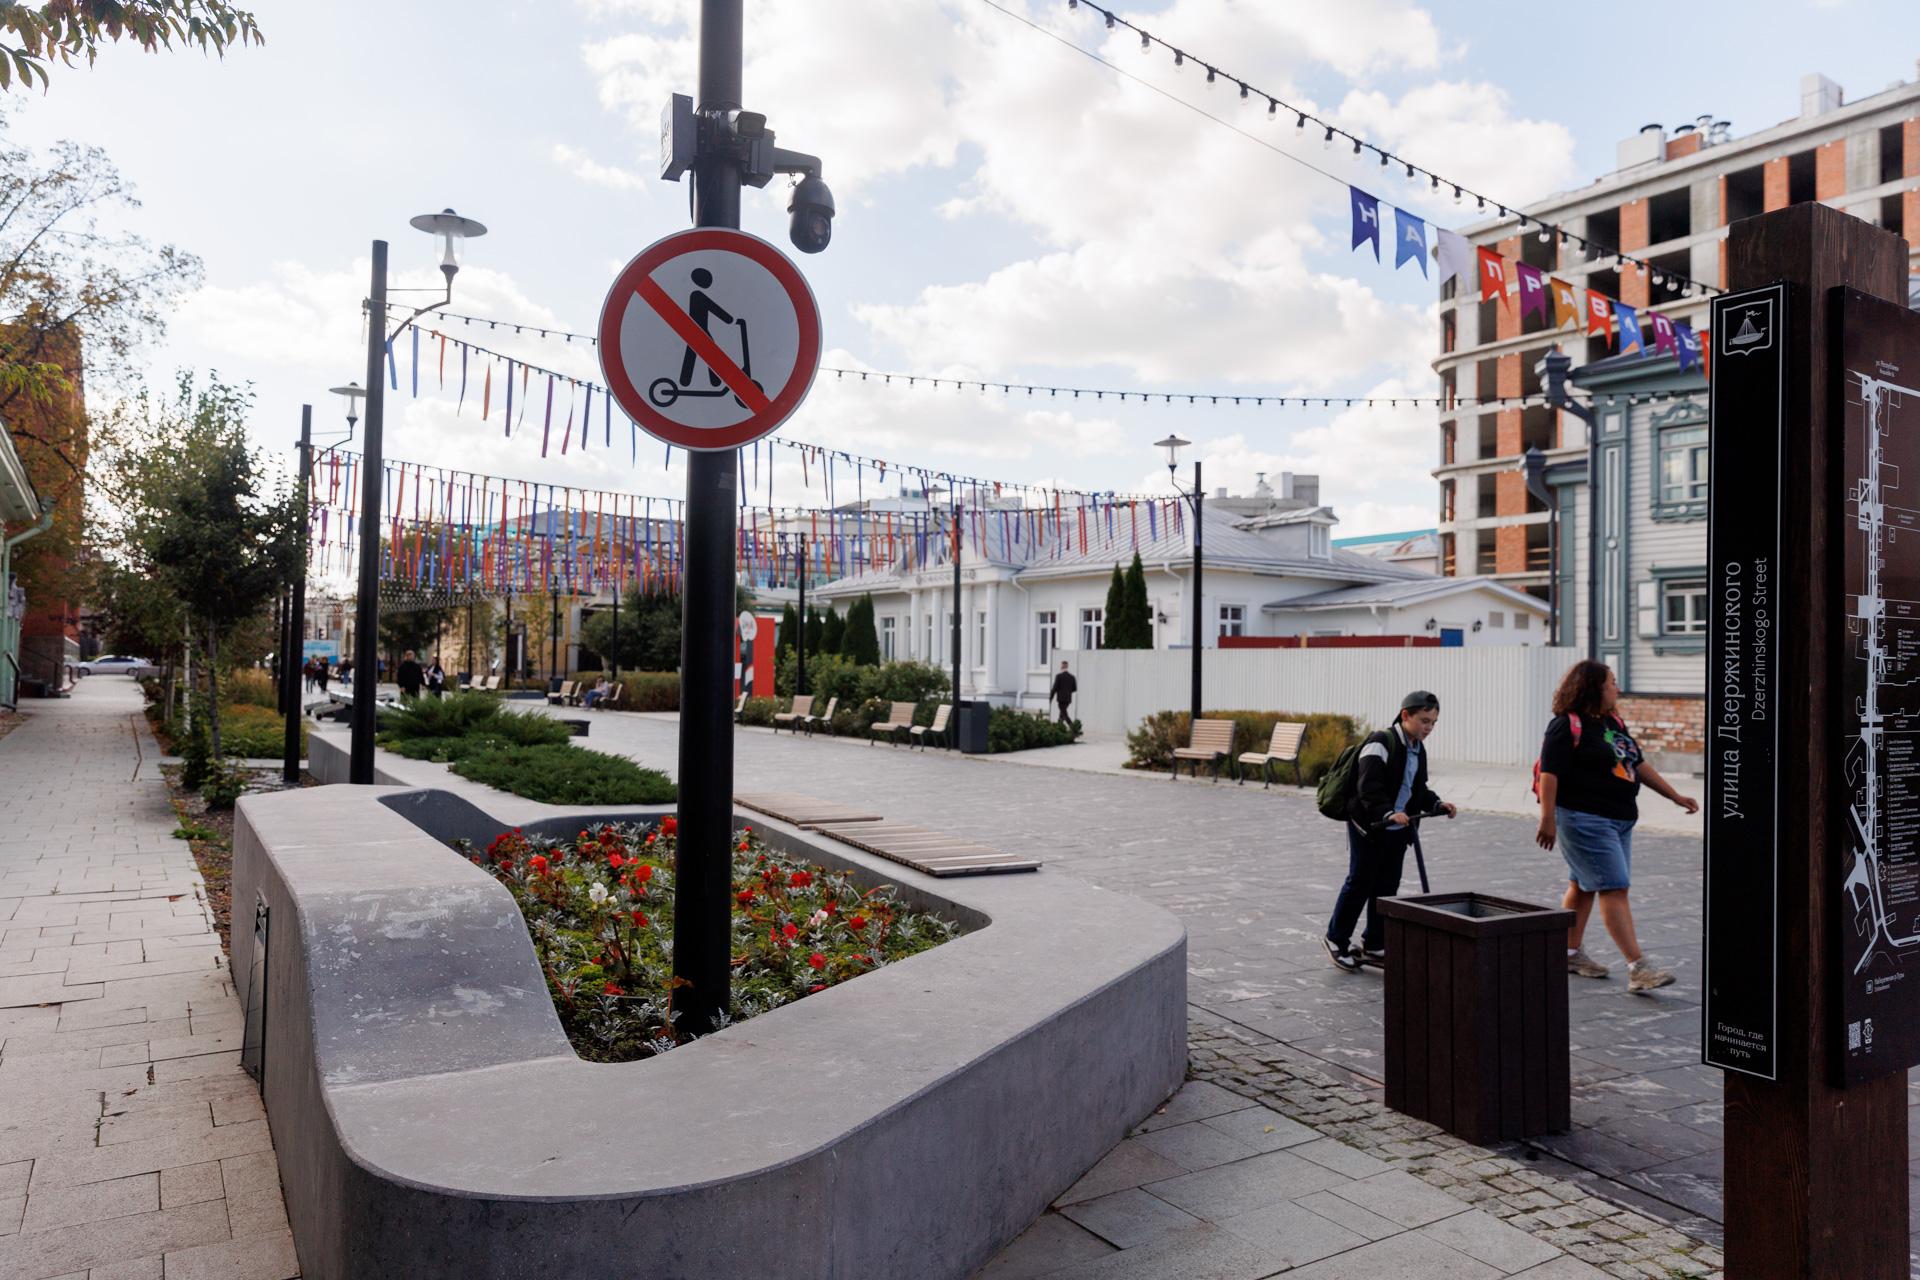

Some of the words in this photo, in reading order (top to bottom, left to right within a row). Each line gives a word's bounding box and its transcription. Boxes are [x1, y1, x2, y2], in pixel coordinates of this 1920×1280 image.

[1753, 557, 1767, 605] Street
[1718, 561, 1745, 743] Дзержинского
[1752, 609, 1770, 721] Dzerzhinskogo
[1723, 749, 1744, 819] улица
[1714, 1033, 1767, 1052] начинается
[1717, 1021, 1746, 1037] Город,
[1748, 1031, 1764, 1040] где
[1730, 1047, 1751, 1058] путь
